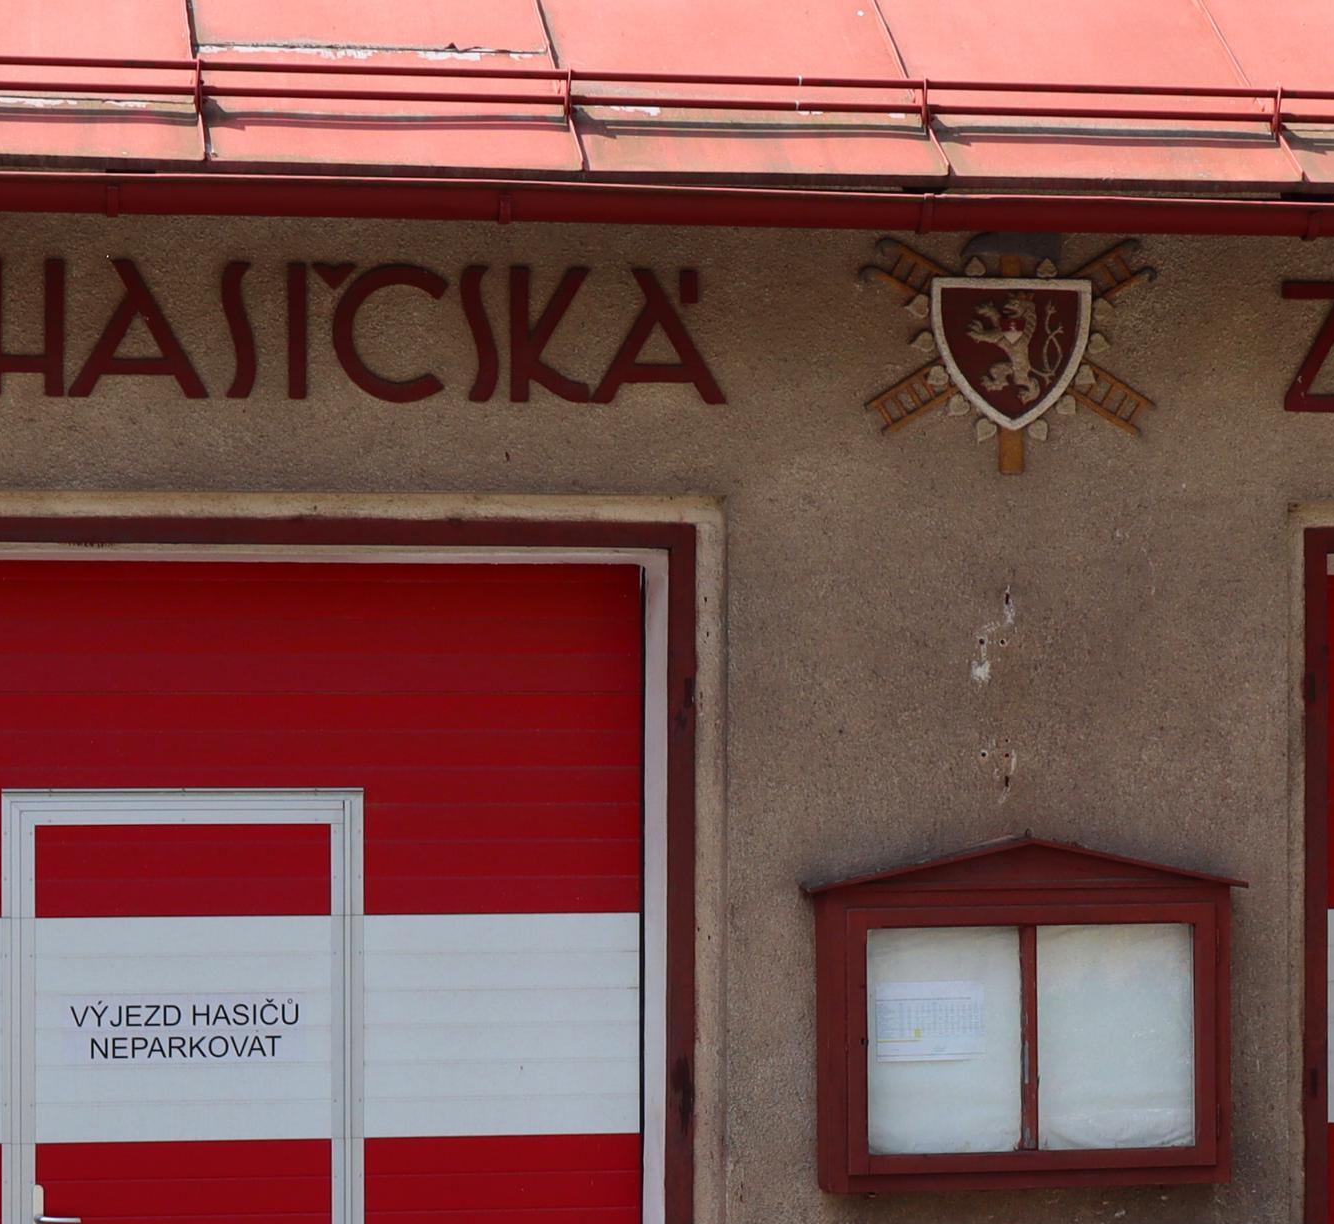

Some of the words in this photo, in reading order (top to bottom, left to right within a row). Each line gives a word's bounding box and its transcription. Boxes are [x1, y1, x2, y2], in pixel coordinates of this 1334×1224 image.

[70, 1000, 182, 1028] VÝJEZD
[192, 998, 300, 1027] HASIČŮ
[90, 1034, 283, 1060] NEPARKOVAT
